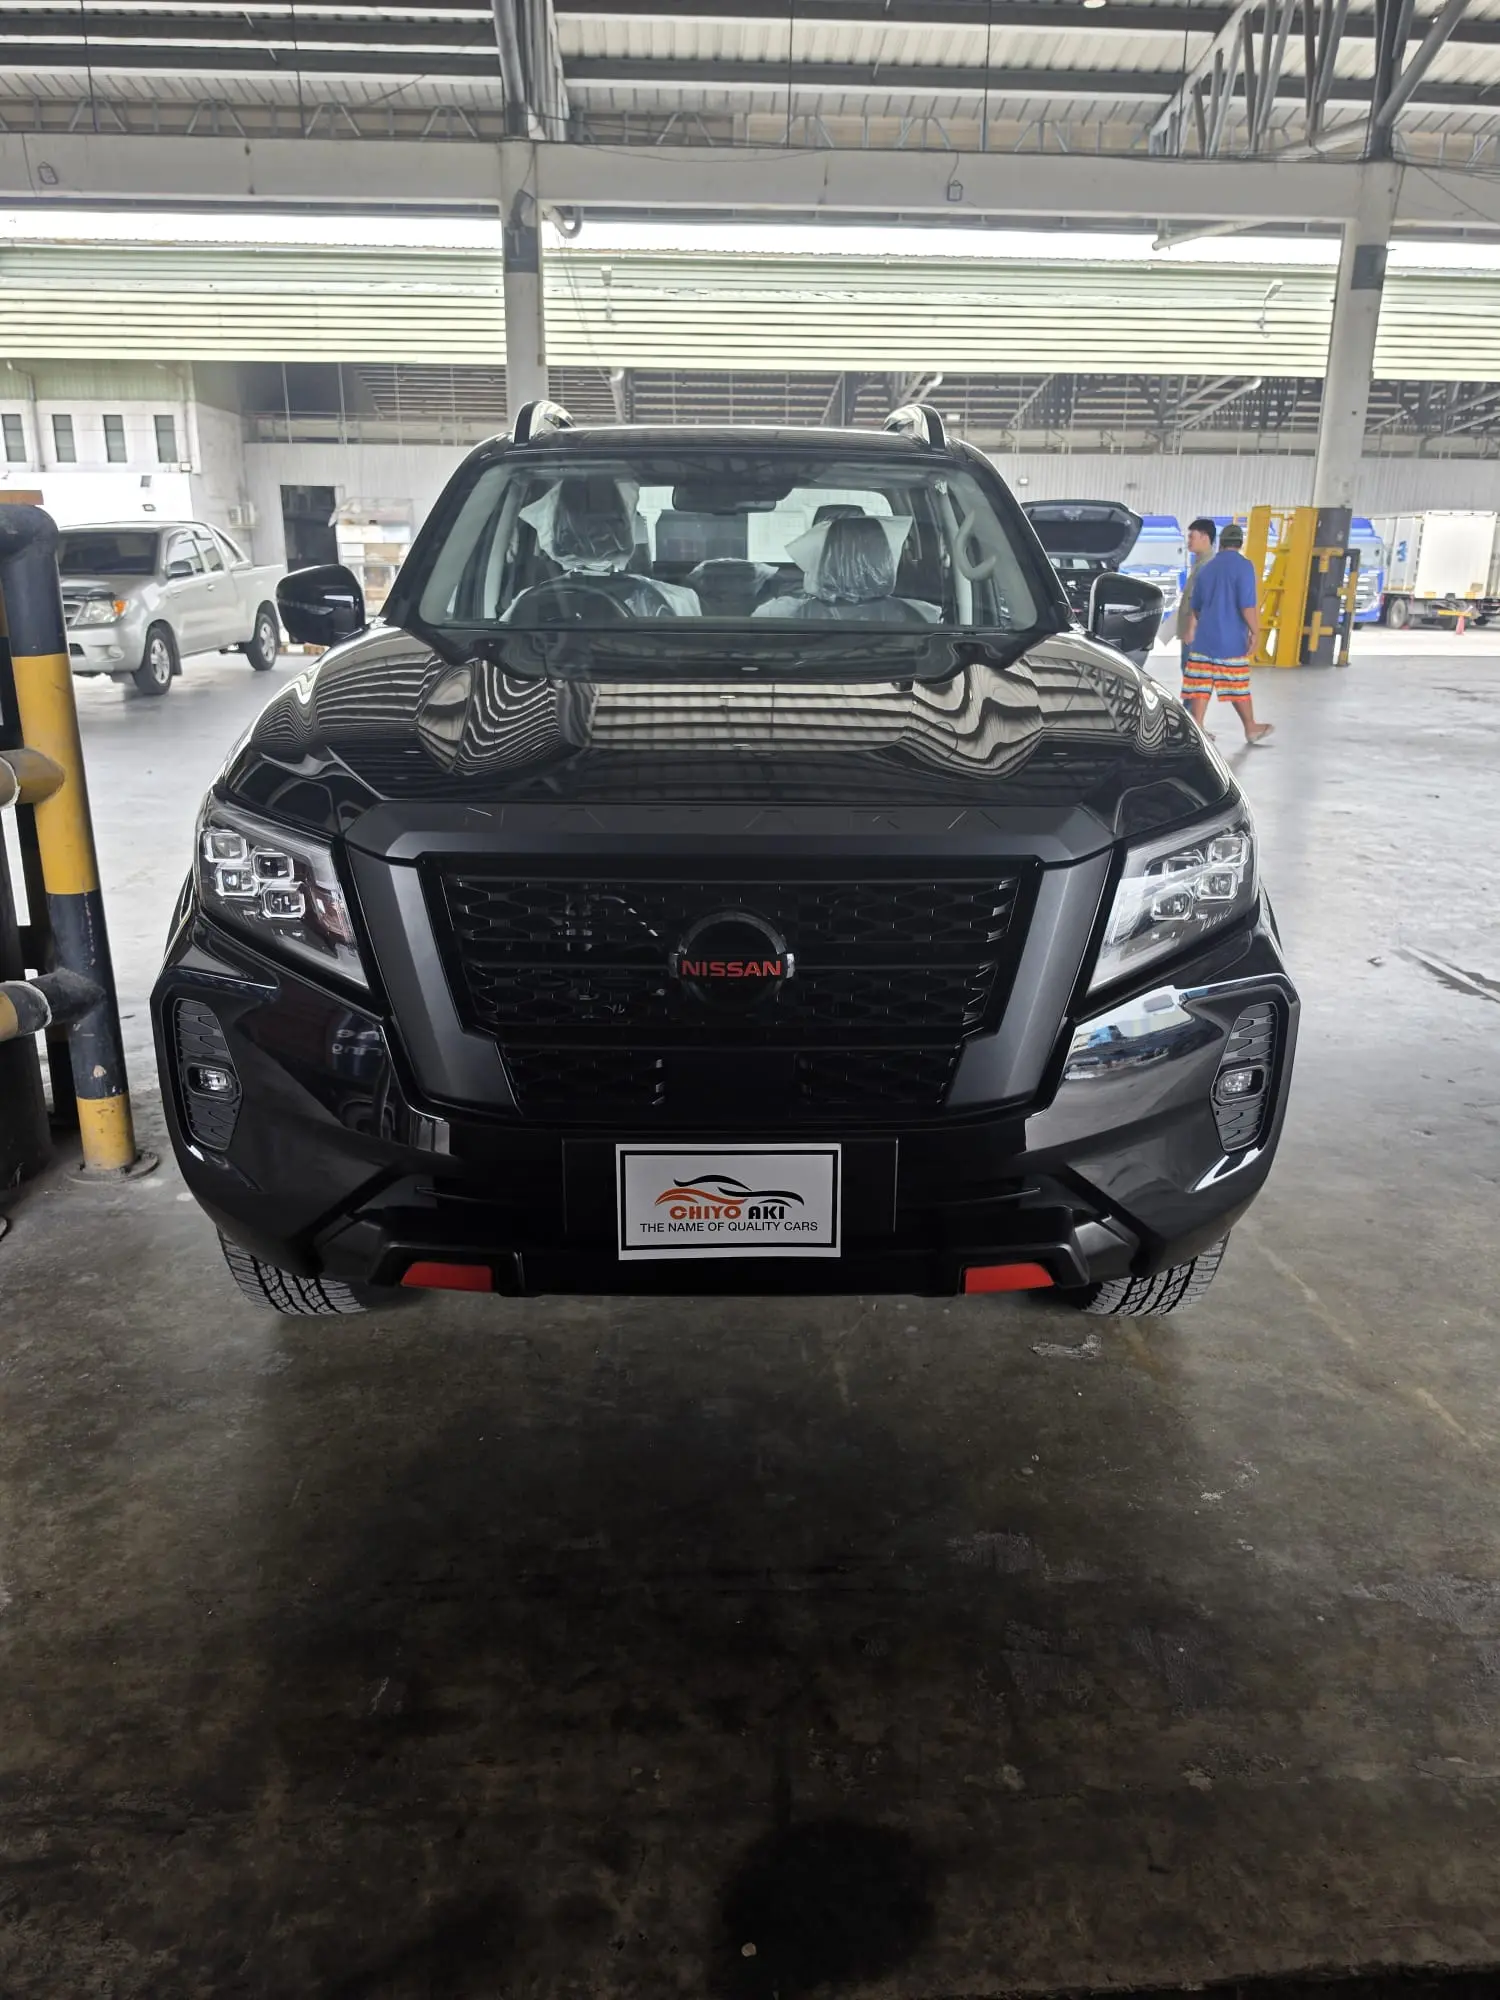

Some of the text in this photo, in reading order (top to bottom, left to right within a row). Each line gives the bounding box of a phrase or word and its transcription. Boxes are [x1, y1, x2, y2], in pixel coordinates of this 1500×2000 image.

[681, 960, 782, 977] NISSAN
[669, 1205, 785, 1220] CHIYO AKI
[640, 1221, 818, 1233] THE NAME OF QUALITY CARS
